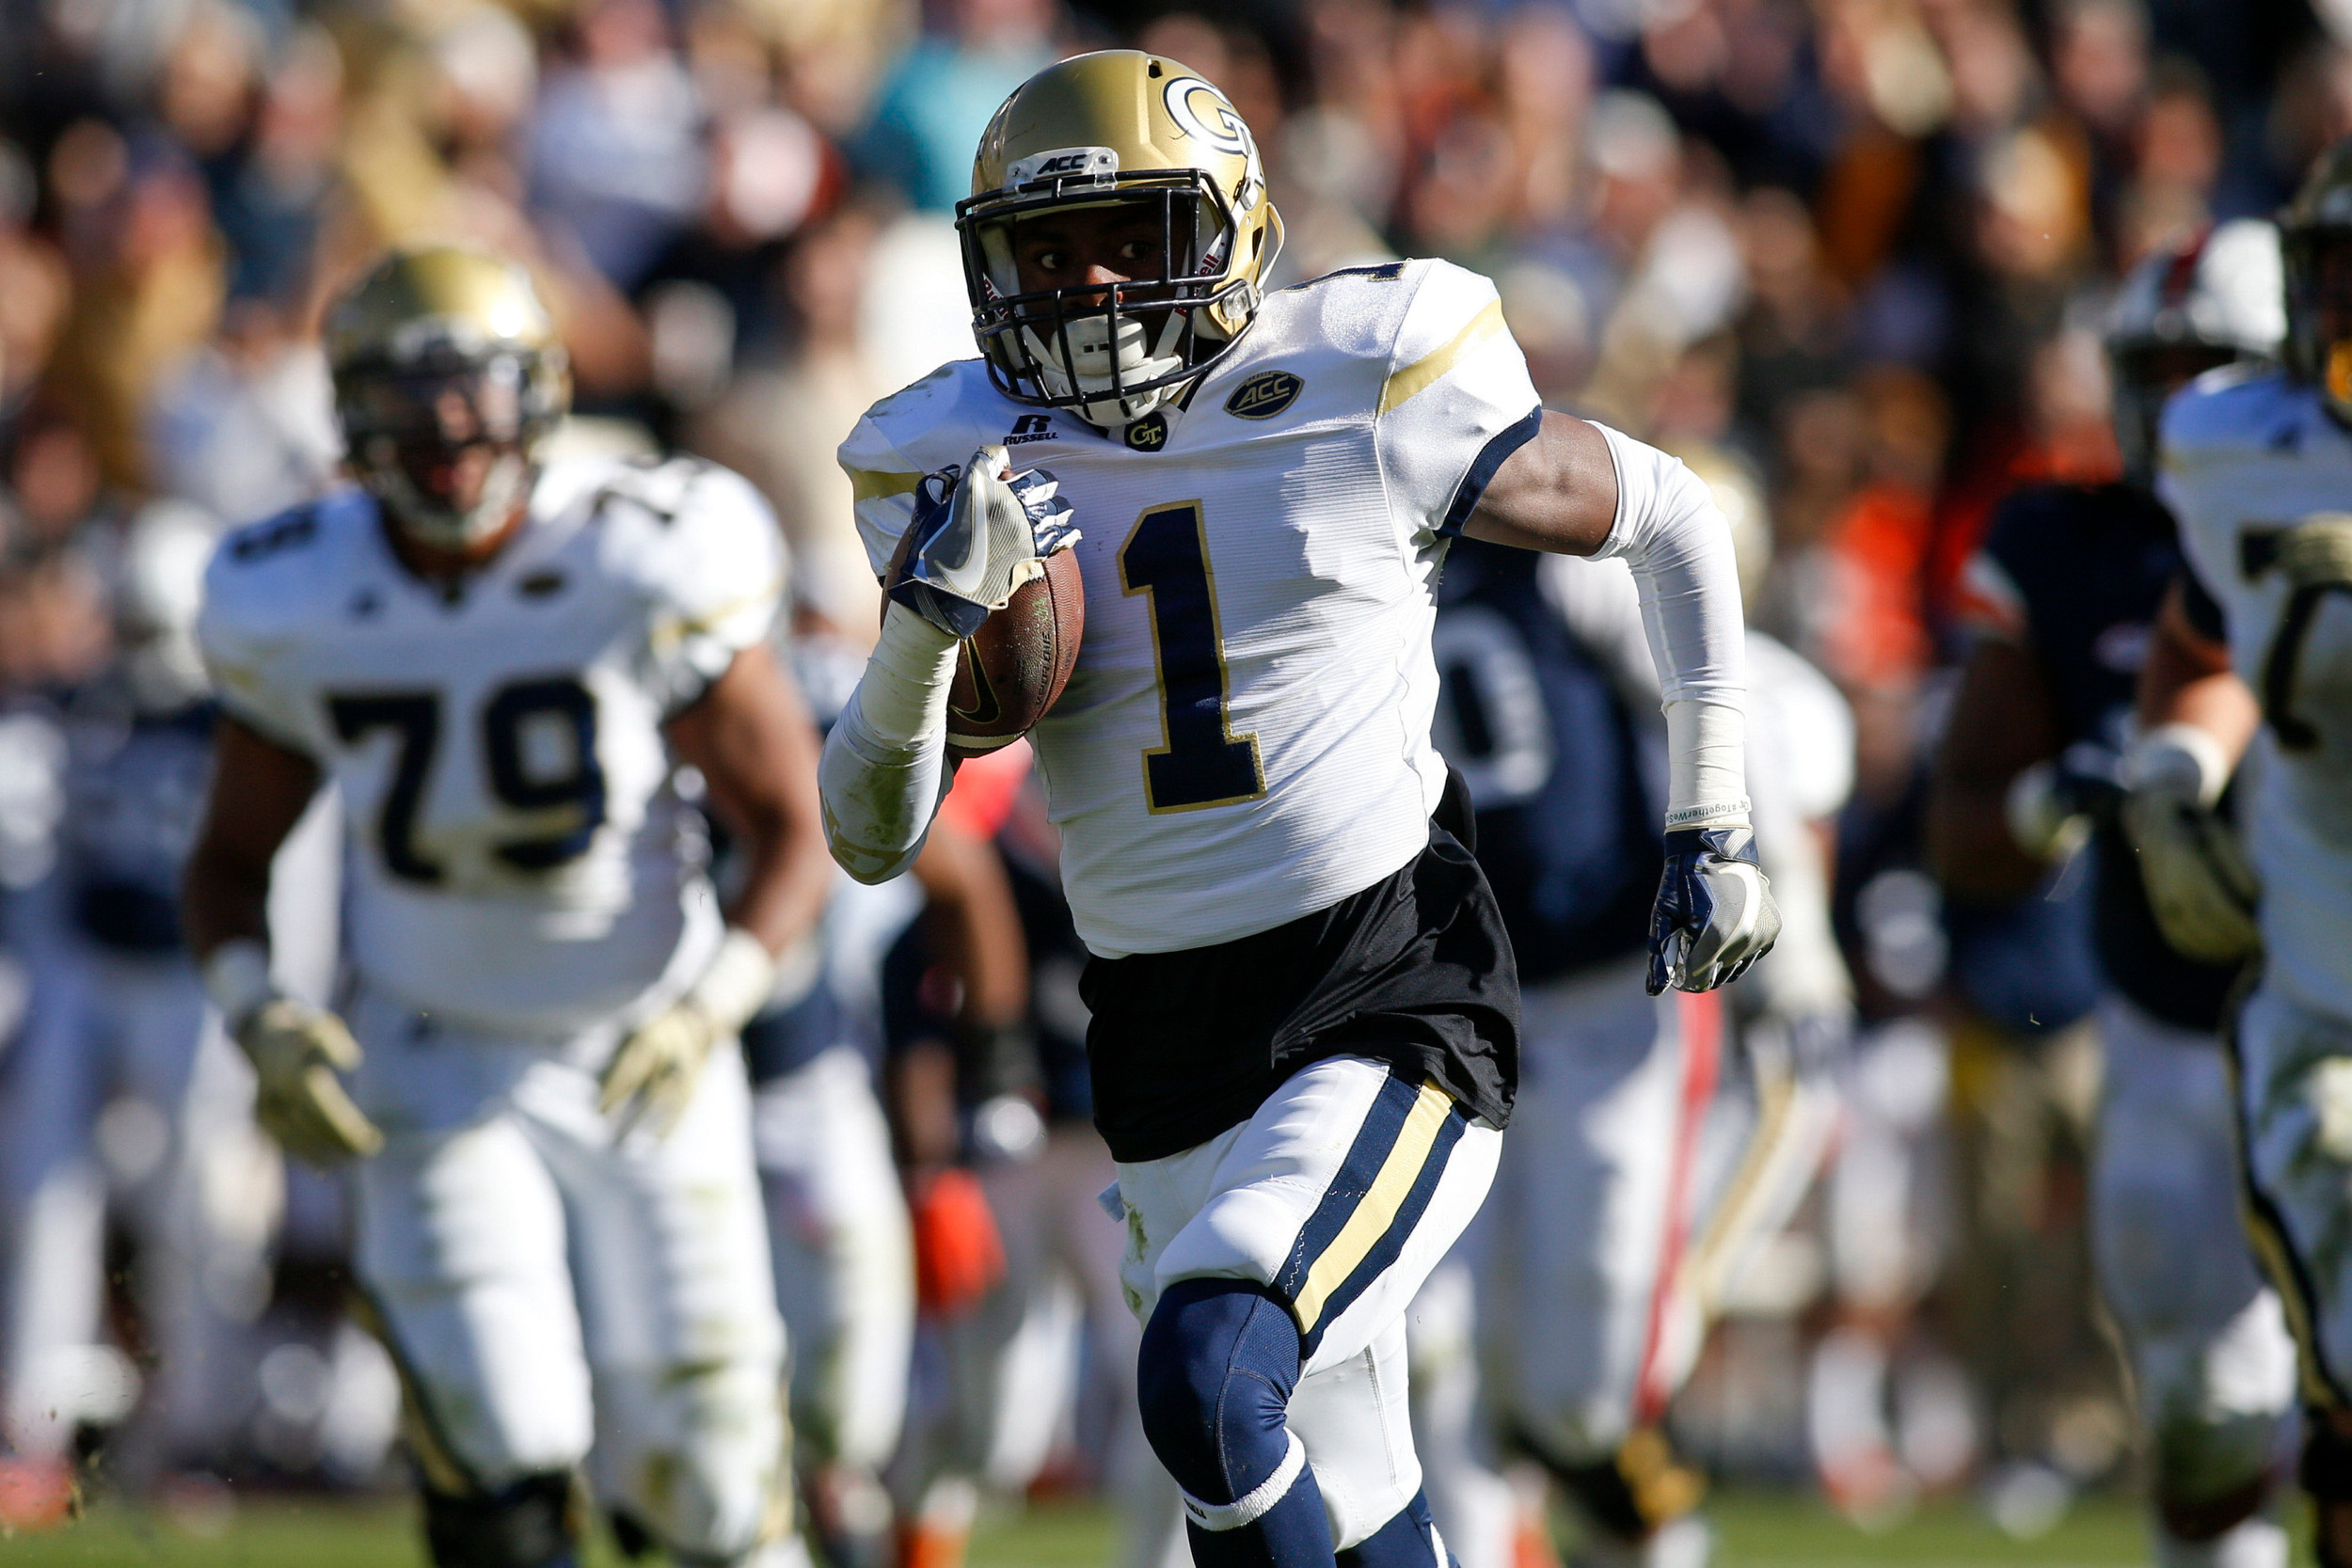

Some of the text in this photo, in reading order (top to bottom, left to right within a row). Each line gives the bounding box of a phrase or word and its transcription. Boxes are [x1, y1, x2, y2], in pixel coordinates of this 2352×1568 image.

[1037, 153, 1087, 175] ACC
[1235, 374, 1291, 408] ACC
[1003, 432, 1058, 446] RUSSELL
[1130, 423, 1162, 445] GT
[1117, 499, 1267, 816] 1
[322, 675, 608, 884] 79
